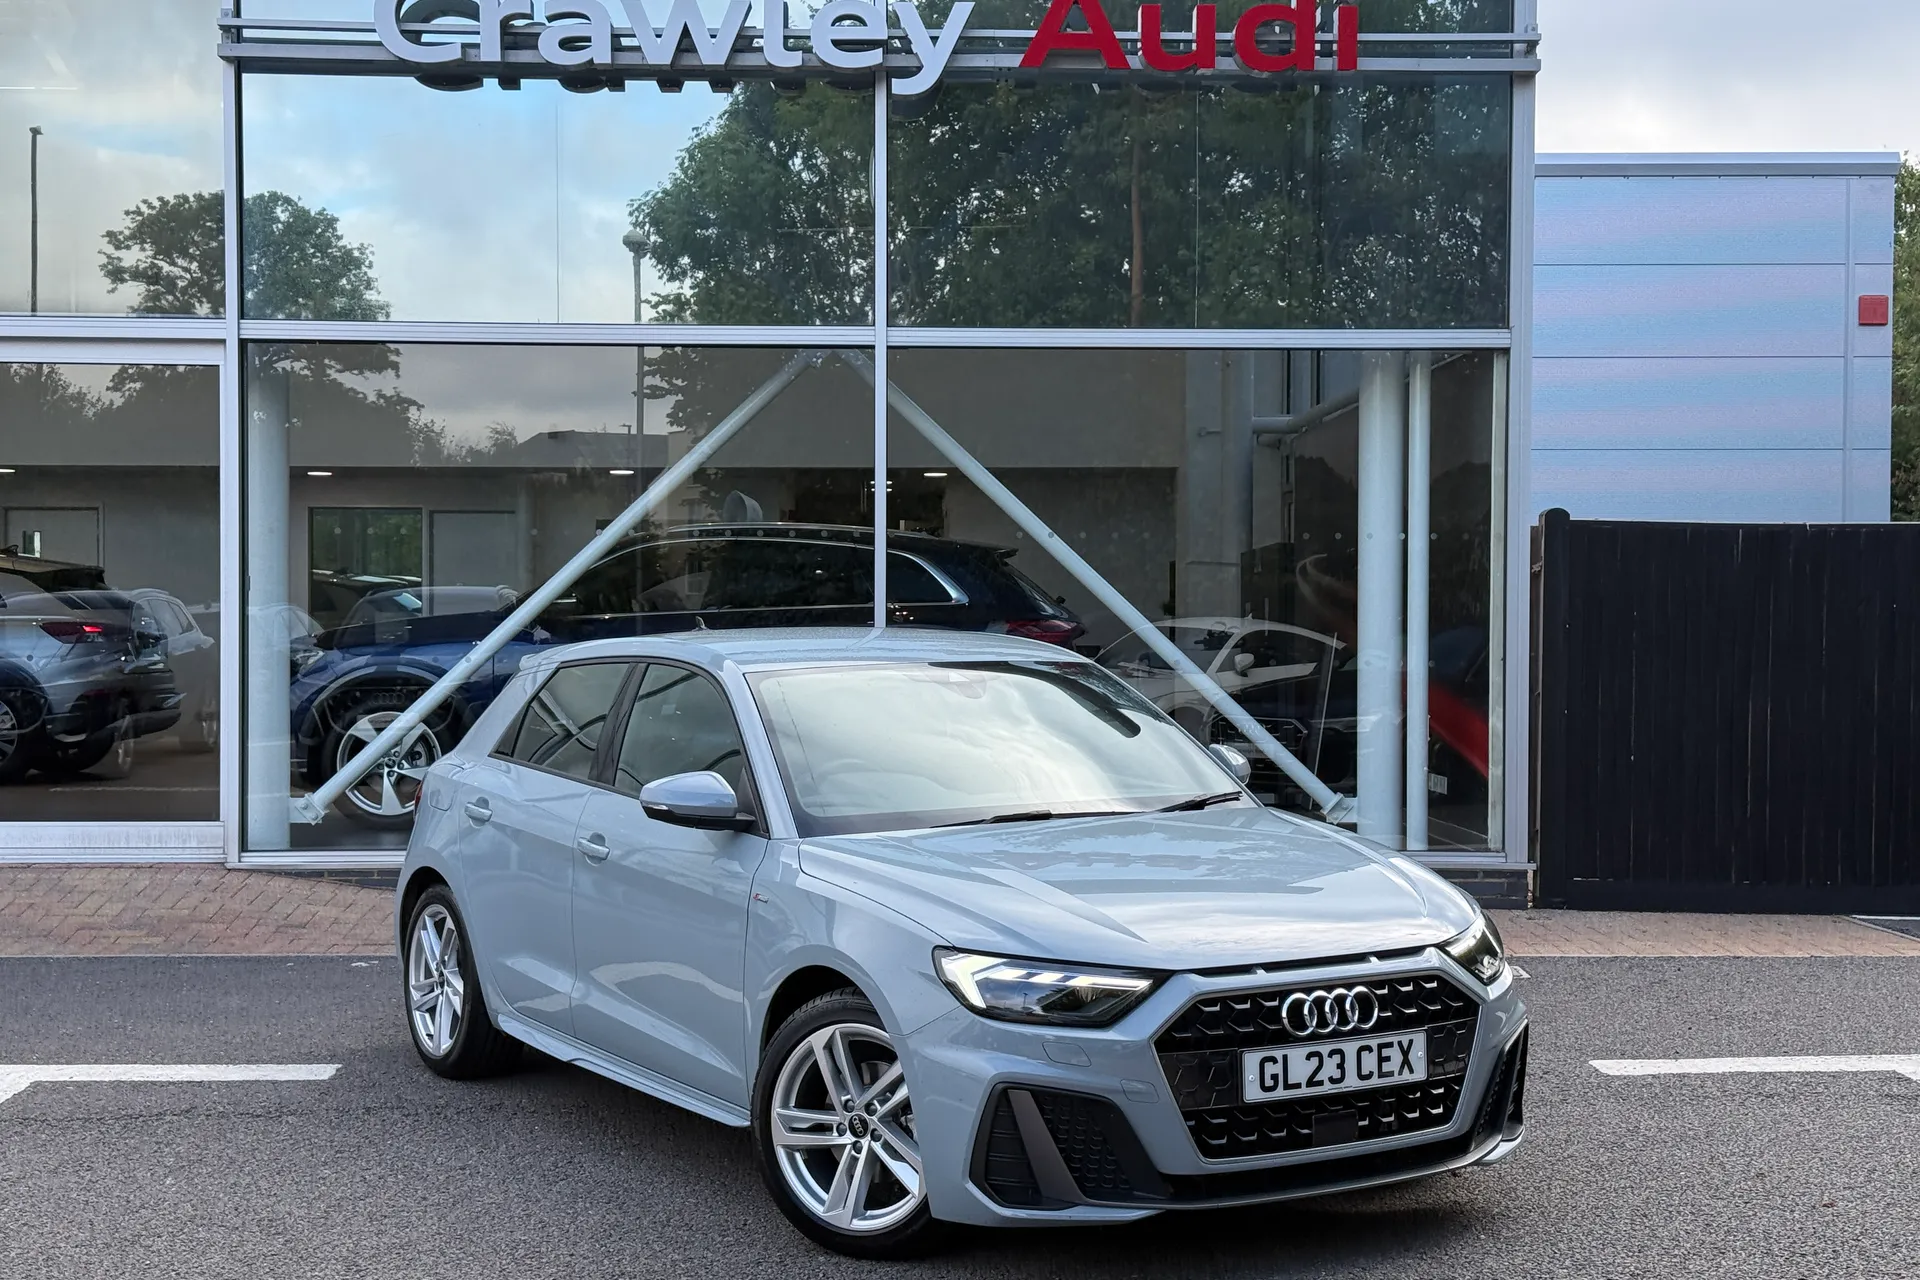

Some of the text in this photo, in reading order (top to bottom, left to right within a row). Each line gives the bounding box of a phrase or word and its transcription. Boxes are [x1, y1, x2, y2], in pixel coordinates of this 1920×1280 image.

[374, 0, 1358, 95] Crawley Audi
[1258, 1038, 1415, 1092] GL23 CEX
